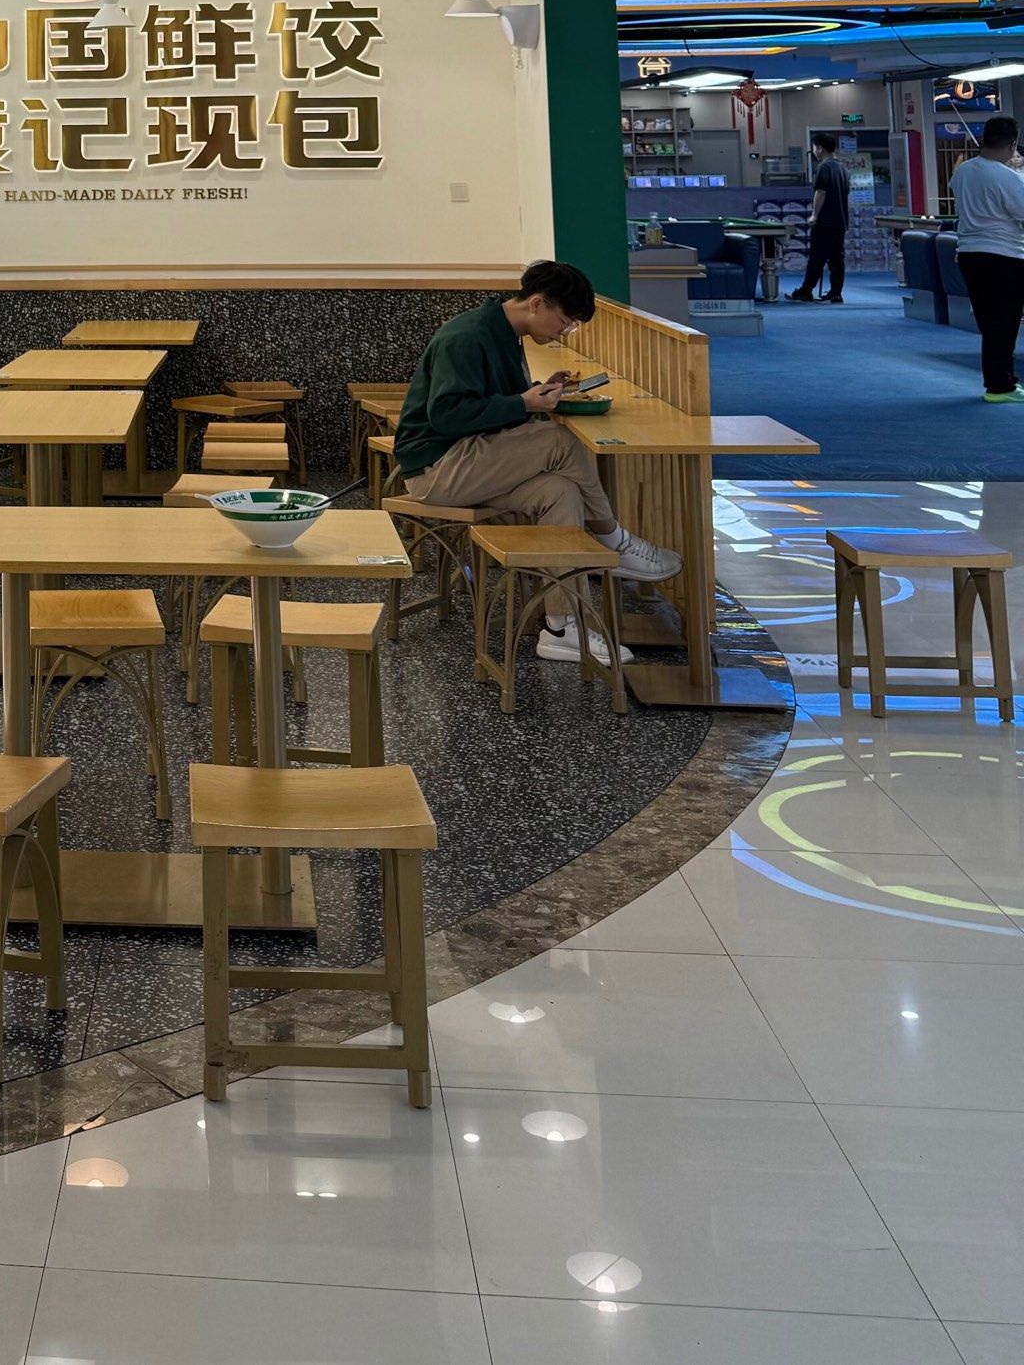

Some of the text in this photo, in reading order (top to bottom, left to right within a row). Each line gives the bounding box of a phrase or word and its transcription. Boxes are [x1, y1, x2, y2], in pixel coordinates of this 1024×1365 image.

[4, 187, 249, 202] HAND-MADE DAILY FRESH!
